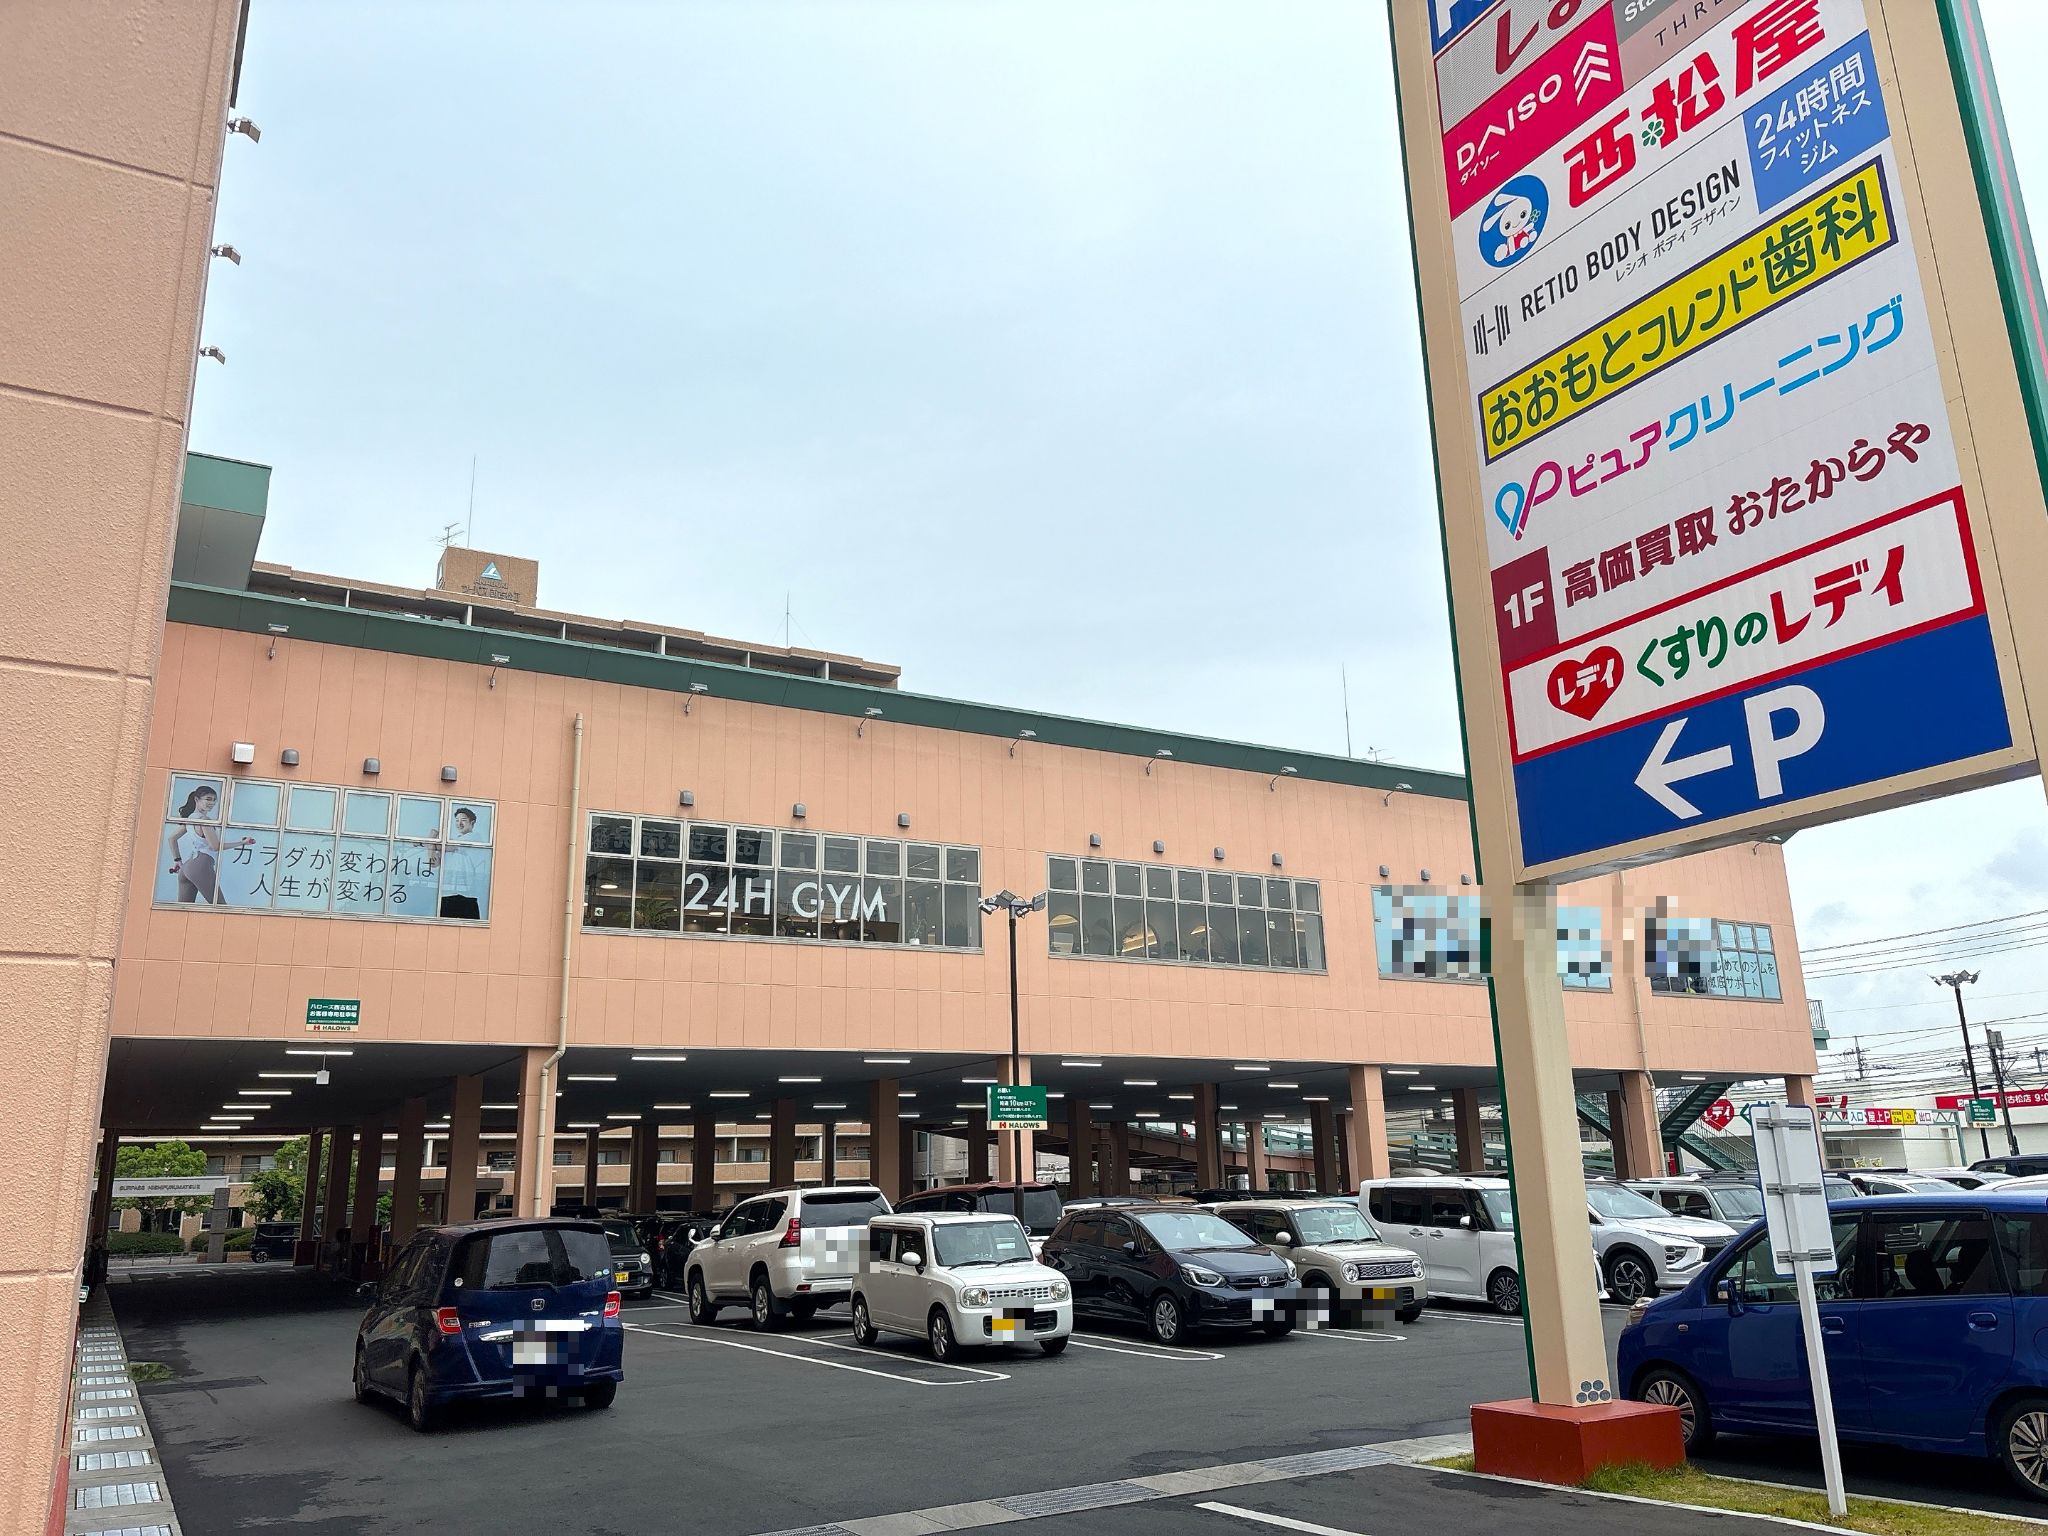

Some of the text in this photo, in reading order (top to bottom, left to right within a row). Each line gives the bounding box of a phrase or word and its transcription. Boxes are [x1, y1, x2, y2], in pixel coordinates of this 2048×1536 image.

[1456, 73, 1562, 172] DAISO
[1562, 0, 1826, 208] 西松屋
[1754, 51, 1866, 150] 24時間
[1760, 89, 1872, 171] フィットネス
[1460, 150, 1501, 186] ダイソー
[1800, 140, 1839, 174] ジム
[1520, 159, 1740, 322] RETIO BODY DESIGN
[1616, 195, 1741, 282] レシオ ボディ デザイン
[1489, 179, 1878, 447] おおもとフレンド歯科
[1567, 293, 1905, 497] ピュアクリーニング
[1503, 422, 1931, 629] 1F 高価買取 おたからや
[1557, 544, 1906, 704] レディ くすりのレディ
[1743, 684, 1826, 800] P
[232, 844, 436, 878] カラダが変われば
[249, 873, 408, 905] 人生が変わる
[684, 872, 888, 922] 24H GYM
[1850, 1111, 1864, 1122] 入口
[1918, 1112, 1932, 1122] 出口
